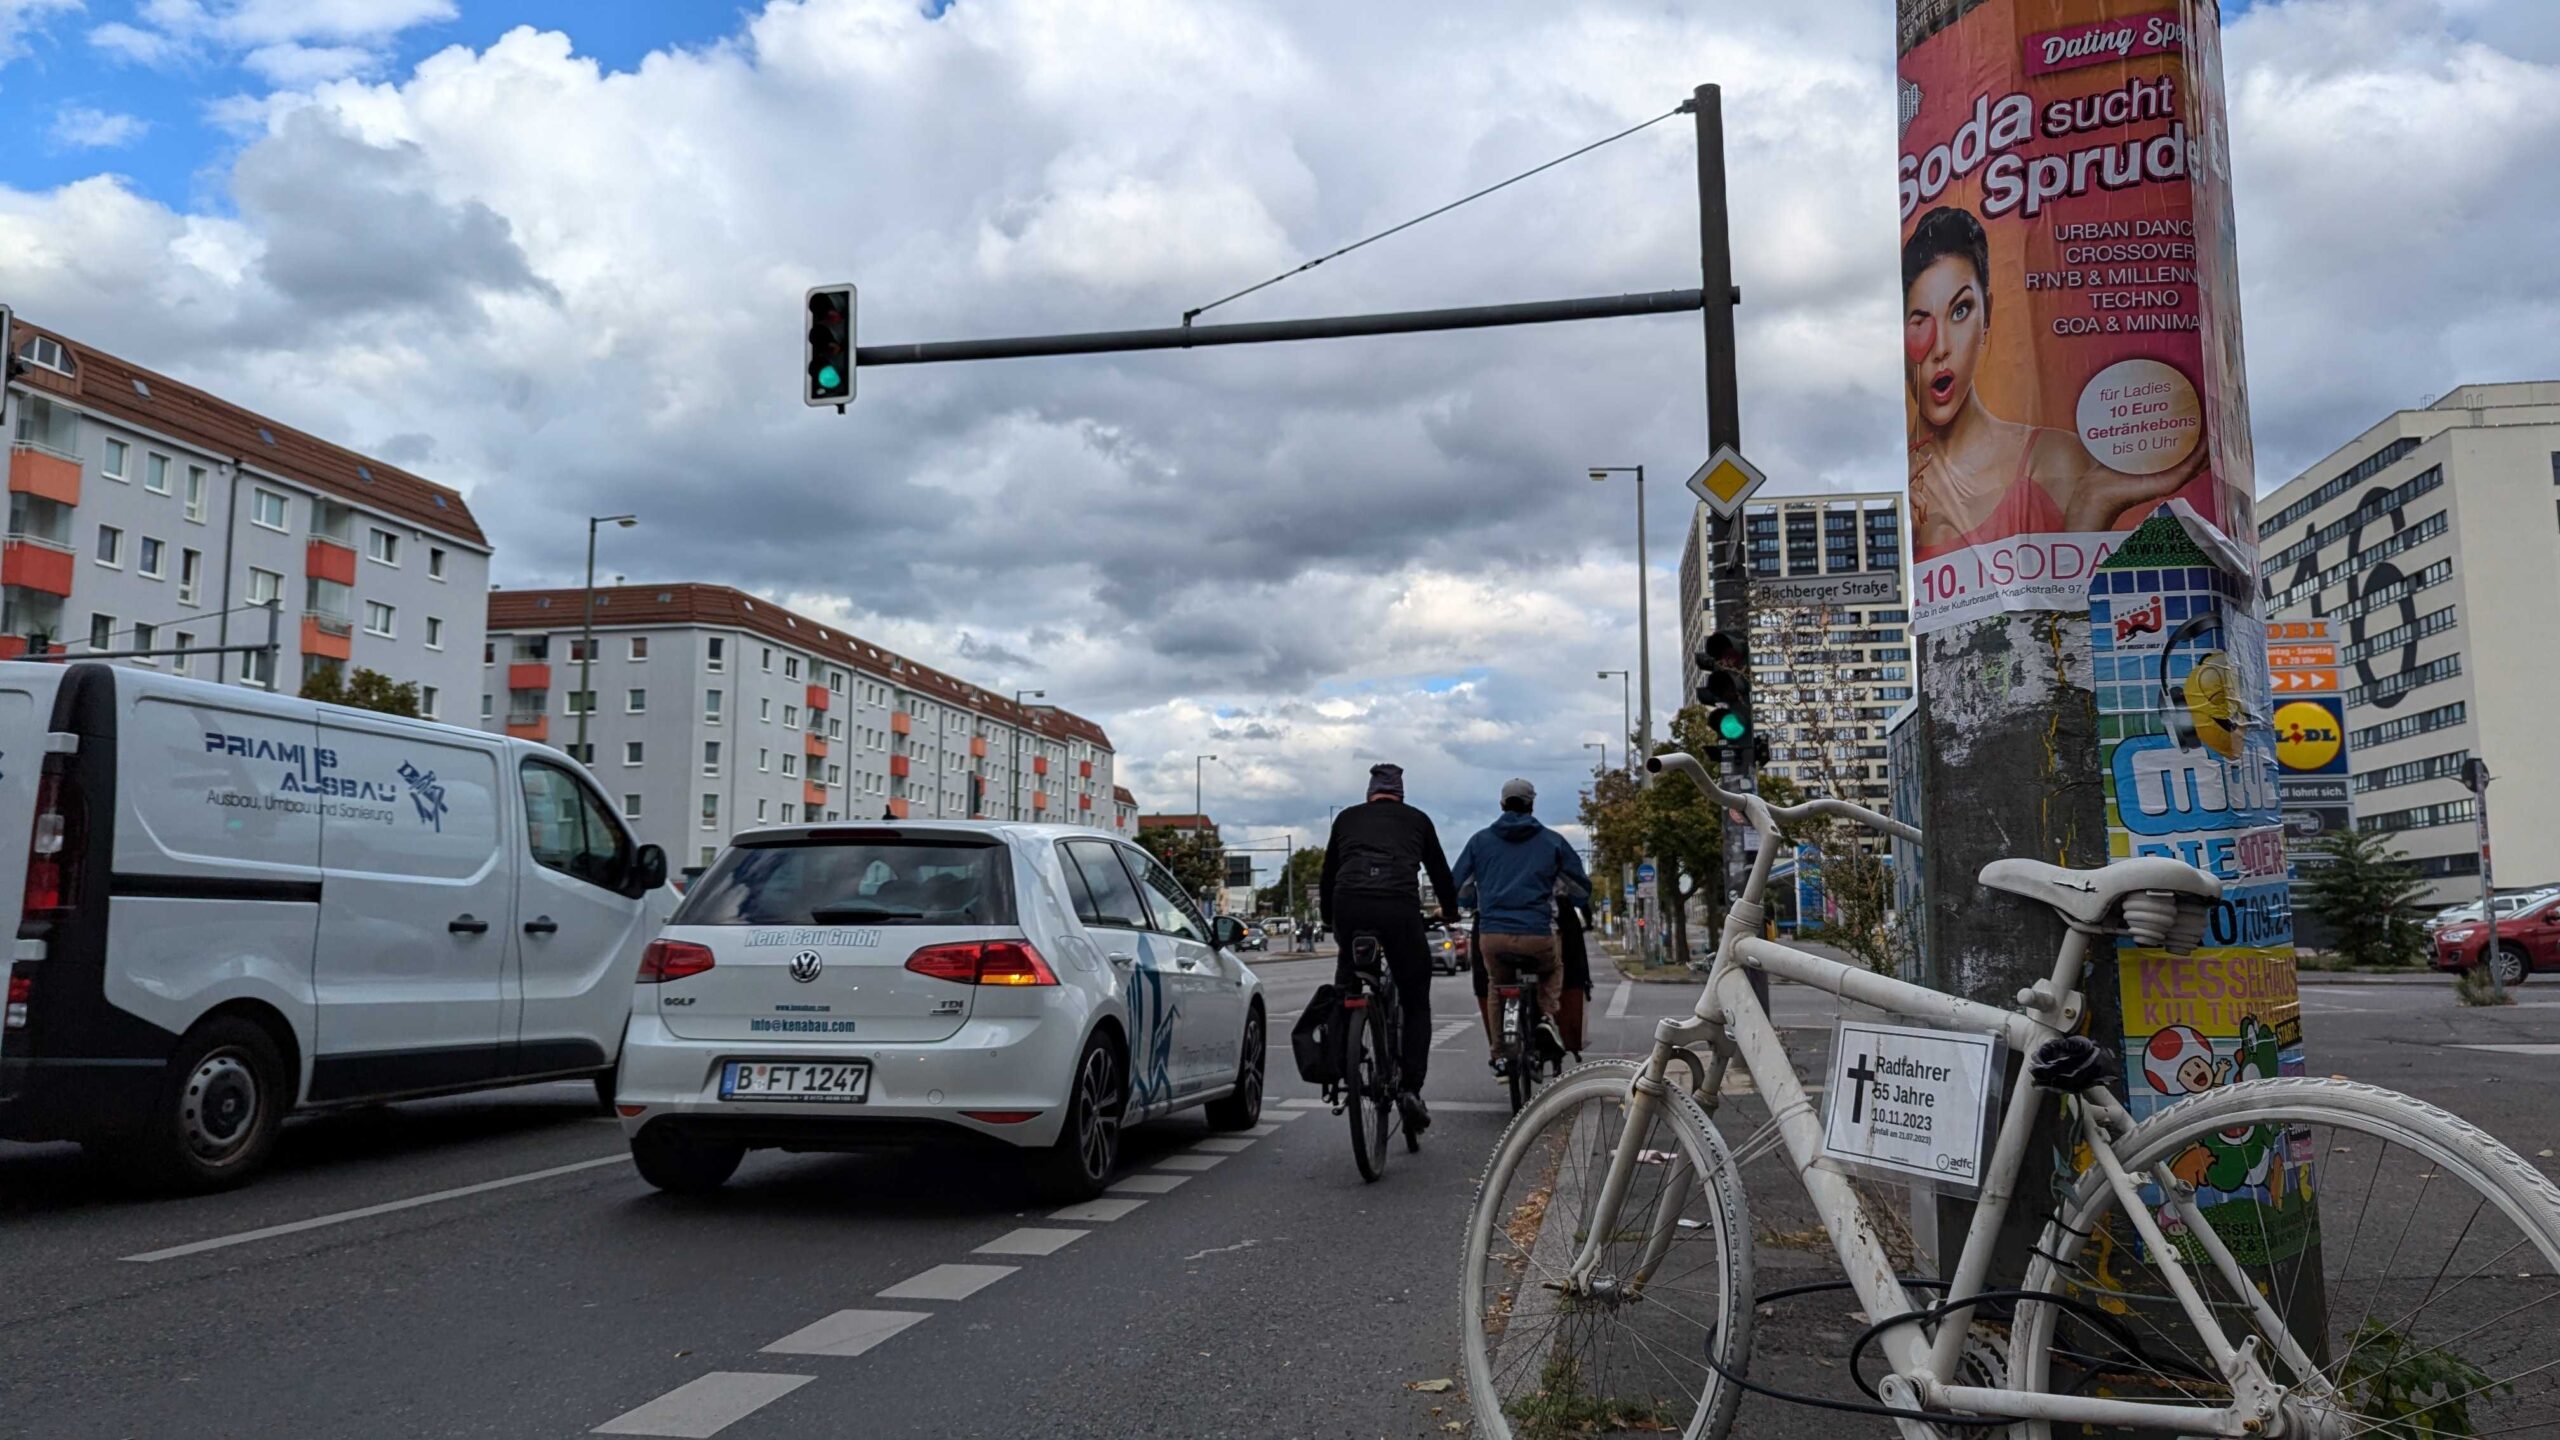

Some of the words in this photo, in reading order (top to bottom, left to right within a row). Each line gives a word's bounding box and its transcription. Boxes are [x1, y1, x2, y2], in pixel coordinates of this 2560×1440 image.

[2042, 26, 2136, 65] Dating
[2045, 77, 2174, 133] sucht
[2055, 220, 2129, 241] URBAN
[2136, 219, 2194, 238] DANC
[2066, 243, 2196, 264] CROSSOVER
[2088, 270, 2102, 286] &
[2109, 267, 2198, 285] MILLENN
[2089, 289, 2178, 309] TECHNO
[2053, 317, 2100, 335] GOA
[2106, 315, 2120, 332] &
[2127, 314, 2200, 331] MINIMA
[2100, 388, 2119, 402] für
[2124, 382, 2171, 398] Ladies
[2110, 405, 2128, 418] 10
[2132, 402, 2168, 415] Euro
[2087, 417, 2196, 440] Getränkebons
[2112, 442, 2134, 455] bis
[2138, 439, 2147, 451] 0
[2152, 436, 2178, 449] Uhr
[1842, 580, 1888, 597] Straße
[1931, 607, 1938, 615] in
[1939, 604, 1950, 613] der
[205, 732, 338, 780] PRIAMUS
[281, 771, 396, 802] AUSBAU
[2292, 787, 2318, 797] lohnt
[2321, 787, 2345, 797] sich.
[206, 789, 262, 810] Ausbau,
[265, 794, 311, 813] Umbau
[314, 800, 337, 816] und
[340, 803, 393, 825] Sanierung
[745, 929, 789, 947] Kena
[790, 929, 826, 946] Bau
[828, 929, 881, 947] GmbH
[2139, 955, 2297, 1000] KESSELHAUS
[751, 1019, 856, 1033] info@kenabau.com
[736, 1066, 753, 1090] B
[767, 1066, 801, 1091] FT
[802, 1067, 865, 1092] 1247
[1876, 1055, 1951, 1082] Radfahrer
[1873, 1083, 1890, 1101] 55
[1893, 1085, 1935, 1108] Jahre
[1871, 1108, 1932, 1131] 10.11.2023
[1950, 1158, 1973, 1169] adfc
